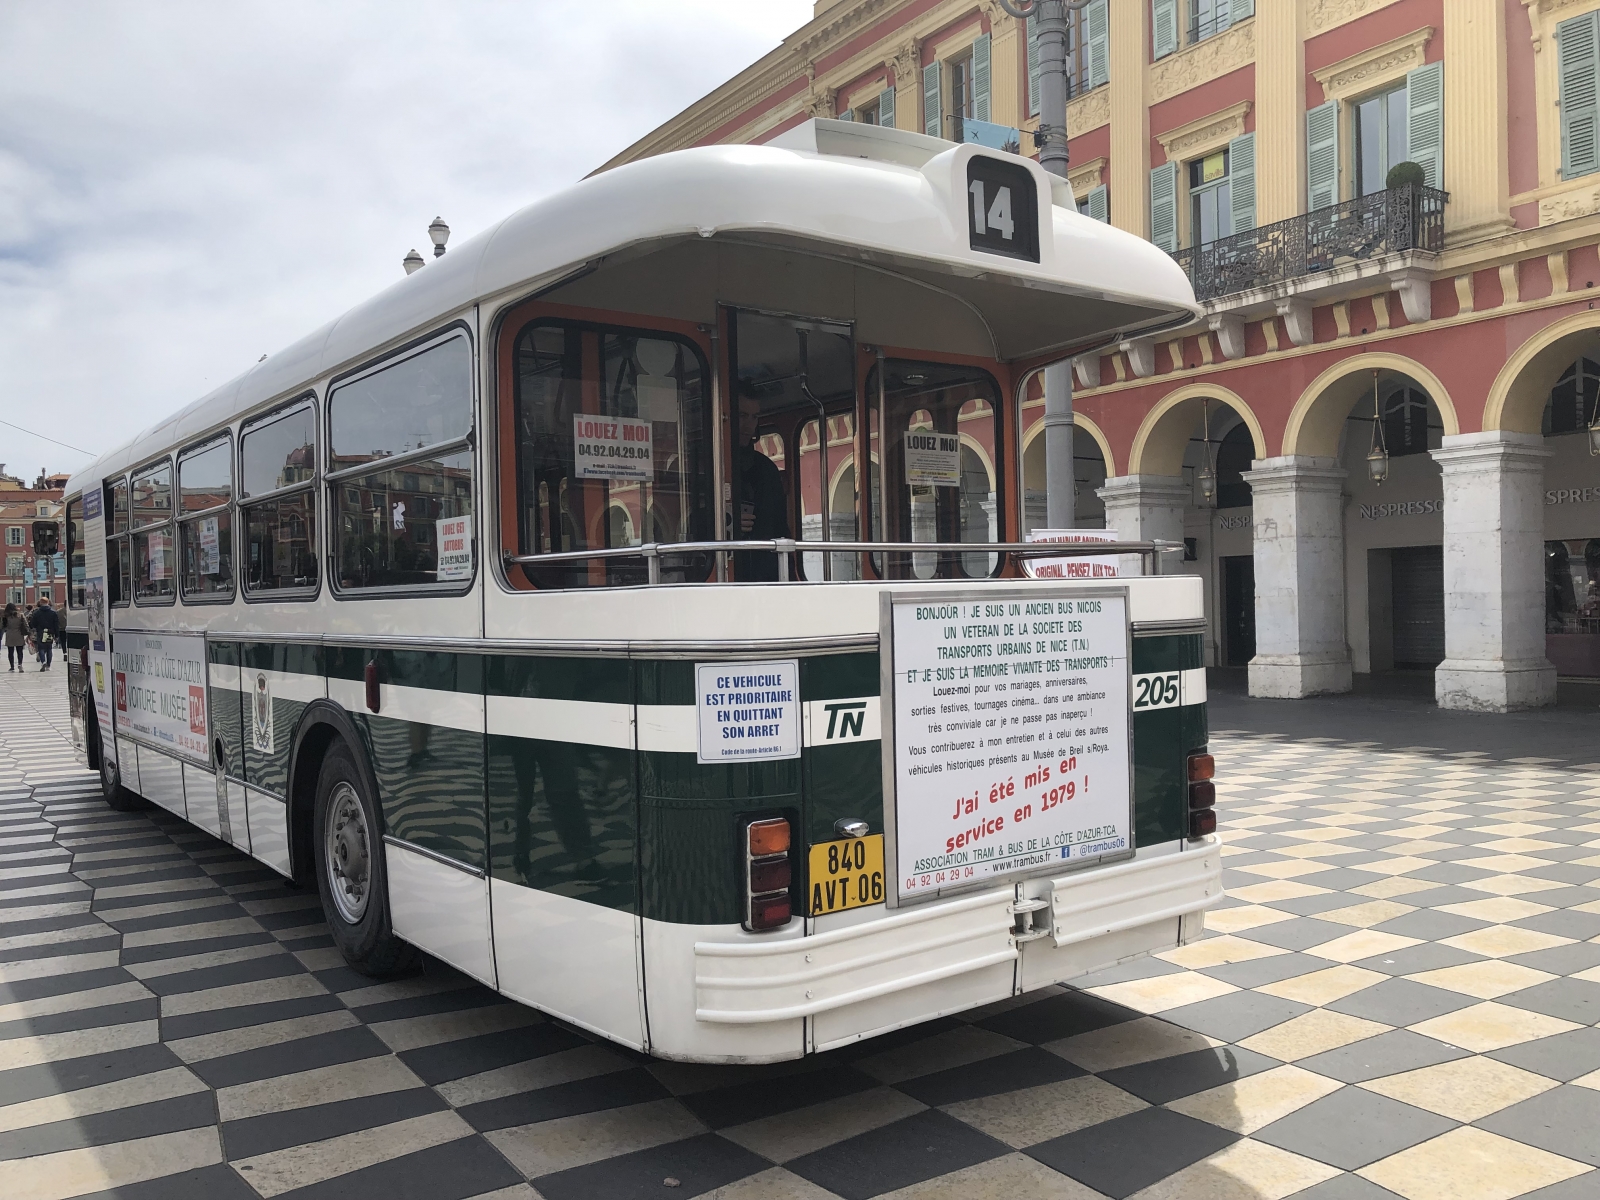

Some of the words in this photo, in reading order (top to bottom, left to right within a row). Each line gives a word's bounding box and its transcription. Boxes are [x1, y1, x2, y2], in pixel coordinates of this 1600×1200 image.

[969, 180, 1014, 240] 14
[578, 421, 618, 440] LOUEZ
[623, 424, 649, 442] MOI
[908, 436, 936, 450] LOUEZ
[940, 438, 958, 452] MOI
[578, 444, 650, 460] 04.92.04.29.04
[1359, 500, 1444, 520] NESPRESSO
[444, 538, 464, 552] AUTOBUS
[1067, 563, 1091, 578] PENSEZ
[1092, 563, 1103, 577] AUX
[1104, 564, 1116, 577] TCA
[916, 606, 958, 620] BONJOUR
[970, 606, 980, 618] JE
[986, 604, 1004, 618] SUIS
[1008, 604, 1020, 616] UN
[1026, 603, 1054, 615] ANCIEN
[1058, 602, 1072, 614] BUS
[1078, 601, 1102, 613] NICOIS
[944, 626, 956, 639] UN
[962, 624, 999, 638] VETERAN
[1004, 624, 1014, 636] DE
[1018, 623, 1028, 635] LA
[1033, 622, 1064, 634] SOCIETE
[1068, 620, 1082, 632] DES
[937, 644, 992, 660] TRANSPORTS
[997, 642, 1031, 656] URBAINS
[1036, 641, 1046, 653] DE
[1050, 640, 1068, 652] NICE
[1072, 638, 1089, 652] (T.N.)
[116, 652, 128, 672] TRAM
[136, 654, 146, 674] BUS
[154, 656, 160, 678] la
[162, 652, 176, 679] CÔTE
[178, 659, 202, 684] D'AZUR
[908, 670, 917, 683] ET
[922, 668, 931, 682] JE
[936, 667, 954, 681] SUIS
[960, 666, 969, 679] LA
[974, 663, 1008, 678] MEMOIRE
[1013, 660, 1042, 674] VIVANTE
[1046, 660, 1060, 672] DES
[1064, 656, 1108, 670] TRANSPORTS
[116, 680, 126, 705] TCA
[717, 676, 730, 688] CE
[733, 674, 782, 688] VEHICULE
[933, 684, 970, 696] Louez-moi
[974, 684, 990, 695] pour
[994, 684, 1006, 692] vos
[1010, 680, 1042, 691] mariages,
[1046, 676, 1088, 688] anniversaires,
[1135, 675, 1178, 708] 205
[128, 685, 156, 714] VOITURE
[160, 690, 187, 722] MUSÉE
[706, 694, 725, 706] EST
[728, 690, 792, 705] PRIORITAIRE
[911, 705, 936, 716] sorties
[940, 703, 970, 714] festives,
[974, 700, 1008, 710] tournages
[1044, 695, 1058, 704] dans
[1062, 694, 1074, 702] une
[1078, 691, 1106, 701] ambiance
[190, 695, 205, 728] TCA
[718, 710, 730, 722] EN
[734, 707, 784, 722] QUITTANT
[824, 702, 867, 740] TN
[928, 722, 942, 733] très
[946, 719, 982, 731] conviviale
[986, 718, 996, 728] car
[1000, 716, 1007, 728] je
[1010, 716, 1018, 724] ne
[1022, 714, 1042, 726] passe
[1046, 712, 1058, 723] pas
[1060, 710, 1087, 720] inaperçu
[722, 726, 744, 738] SON
[748, 724, 780, 738] ARRET
[908, 746, 926, 756] Vous
[930, 740, 974, 754] contribuerez
[980, 738, 984, 748] à
[988, 738, 1002, 746] mon
[1006, 733, 1034, 744] entretien
[1038, 732, 1044, 741] et
[1048, 730, 1052, 740] à
[1056, 729, 1072, 738] celui
[1074, 728, 1086, 736] des
[1090, 726, 1108, 735] autres
[908, 763, 942, 776] véhicules
[946, 758, 984, 770] historiques
[988, 754, 1018, 768] présents
[1022, 754, 1030, 762] au
[1034, 748, 1054, 760] Musée
[1058, 748, 1066, 756] de
[1070, 745, 1084, 756] Breil
[952, 790, 978, 820] J'ai
[989, 776, 1014, 804] été
[1024, 764, 1050, 790] mis
[1060, 756, 1076, 774] en
[946, 816, 1004, 854] service
[1014, 804, 1032, 822] en
[1041, 781, 1076, 812] 1979
[1084, 775, 1088, 792] !
[828, 841, 865, 875] 840
[914, 852, 968, 872] ASSOCIATION
[973, 846, 994, 860] TRAM
[998, 845, 1004, 856] &
[1008, 841, 1023, 854] BUS
[1028, 839, 1038, 850] DE
[1042, 836, 1050, 848] LA
[1054, 830, 1073, 846] CÔTE
[1077, 824, 1116, 841] D'AZUR-TCA
[906, 878, 916, 890] 04
[920, 874, 930, 886] 92
[936, 872, 945, 884] 04
[950, 869, 960, 880] 29
[964, 866, 974, 878] 04
[992, 851, 1050, 872] www.trambus.fr
[1080, 838, 1125, 856] @trambus06
[812, 877, 850, 914] AVT
[858, 872, 882, 903] 06
